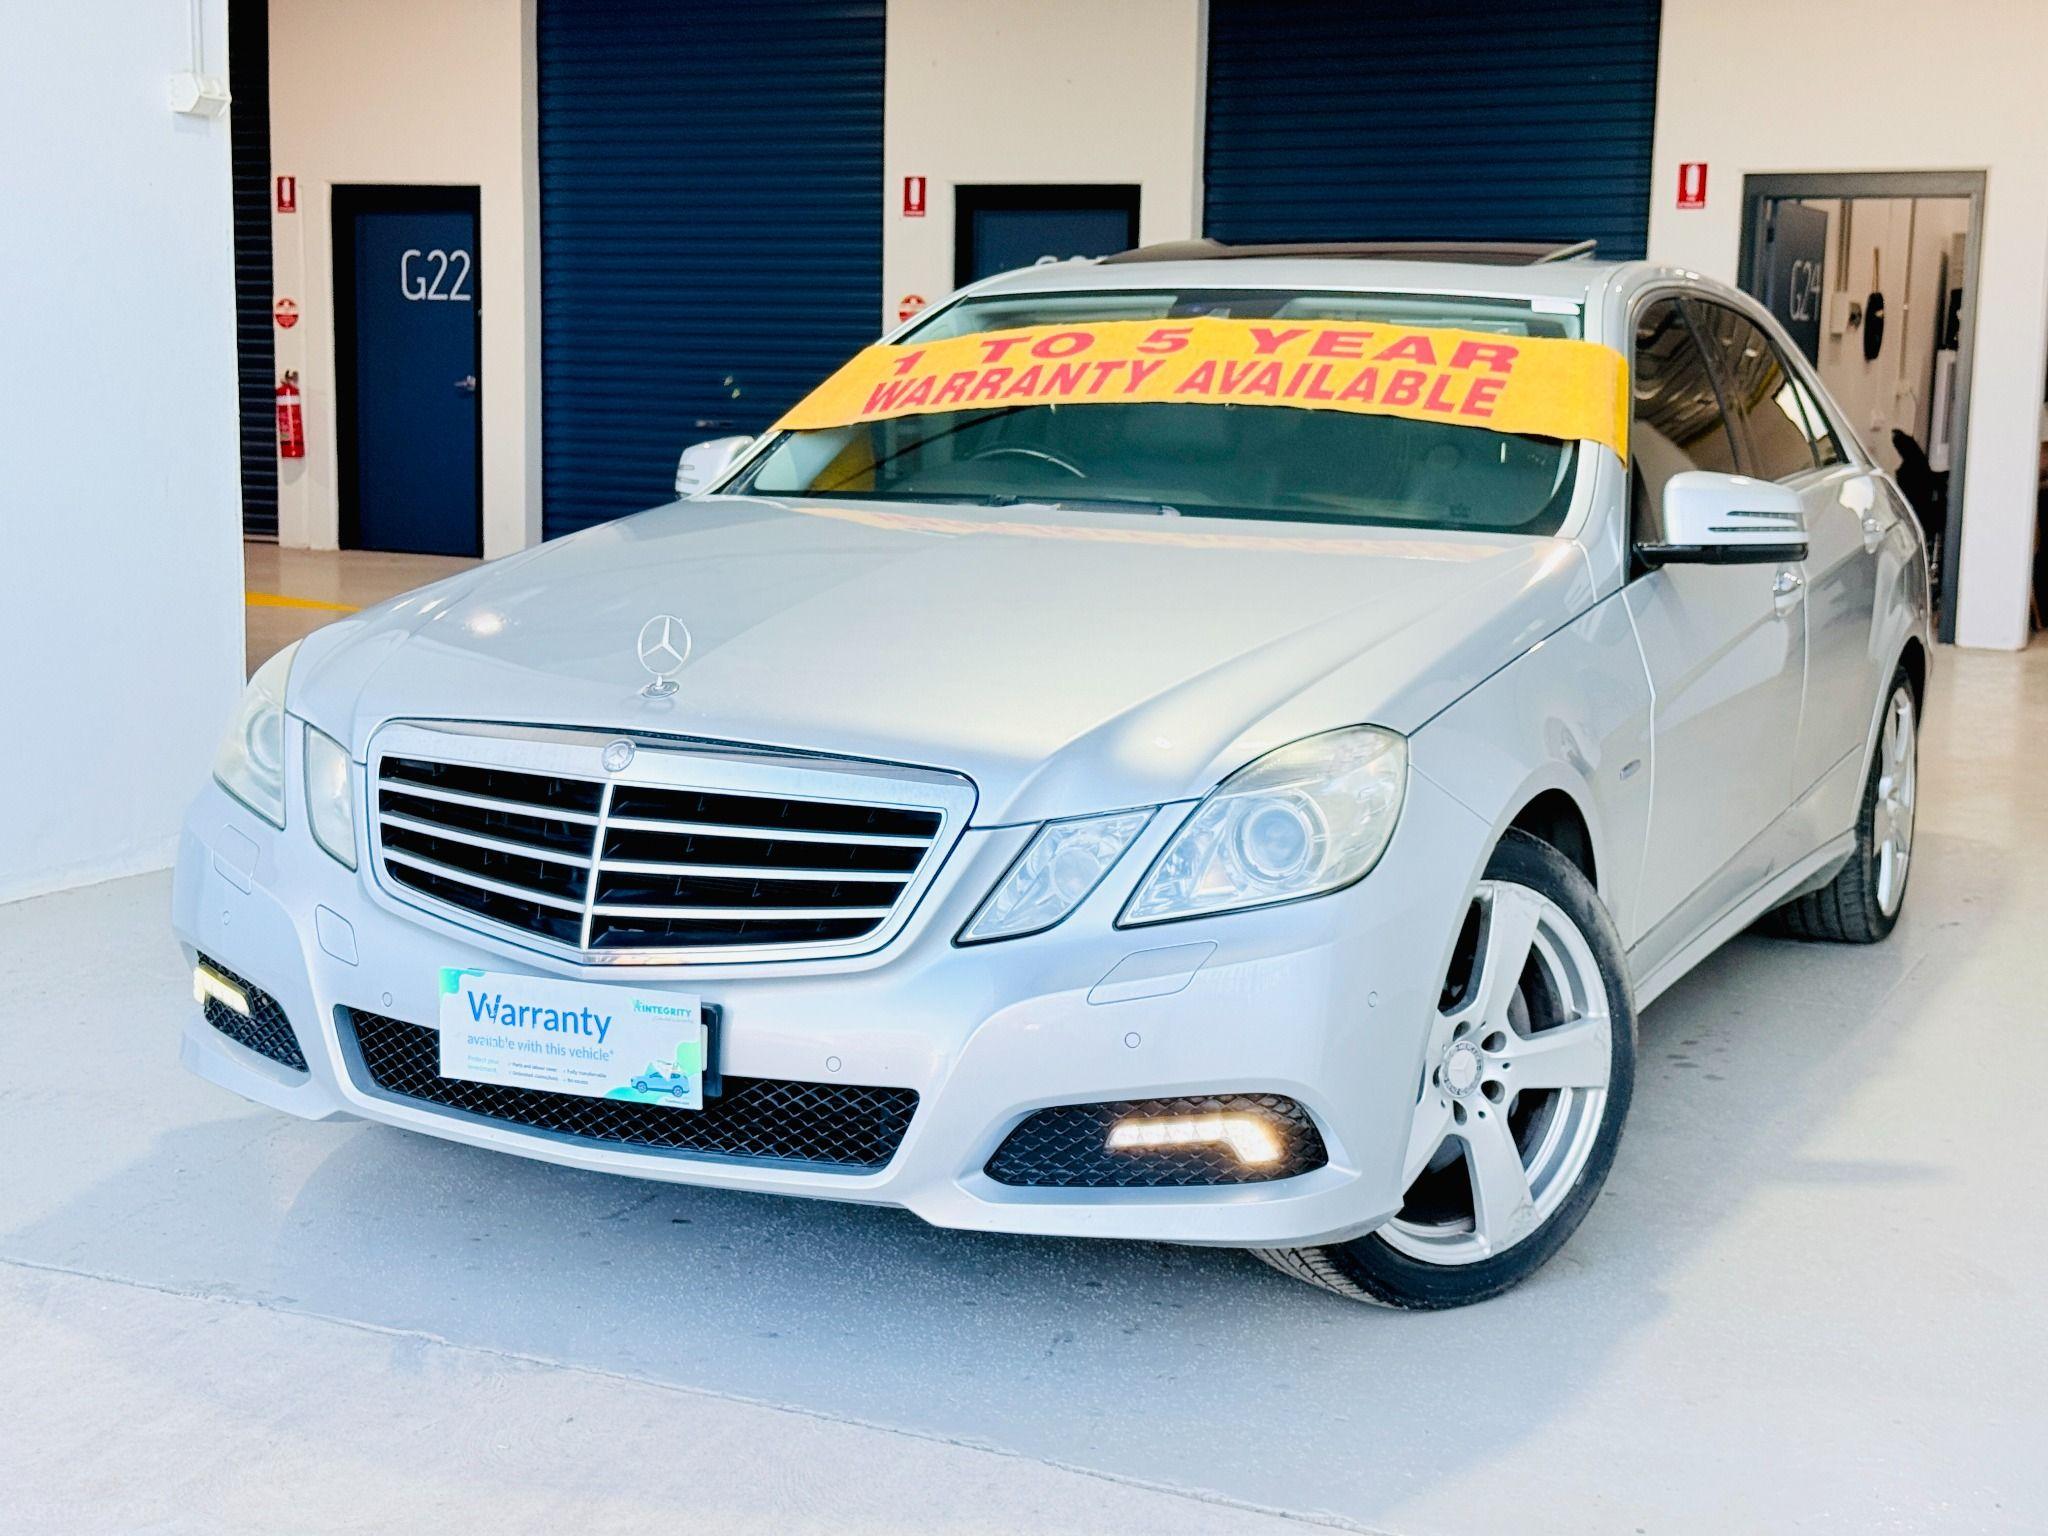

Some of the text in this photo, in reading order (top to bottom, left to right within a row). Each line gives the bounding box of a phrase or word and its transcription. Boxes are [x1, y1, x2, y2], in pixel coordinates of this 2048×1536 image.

[401, 249, 472, 301] G22
[1790, 259, 1821, 321] G24
[893, 327, 1520, 376] 1 TO 5 YEAR
[862, 359, 1507, 418] WARRANTY AVAILABLE
[467, 990, 612, 1044] Warranty
[642, 1004, 692, 1017] INTEGRITY
[518, 1040, 542, 1055] with
[545, 1042, 567, 1057] this
